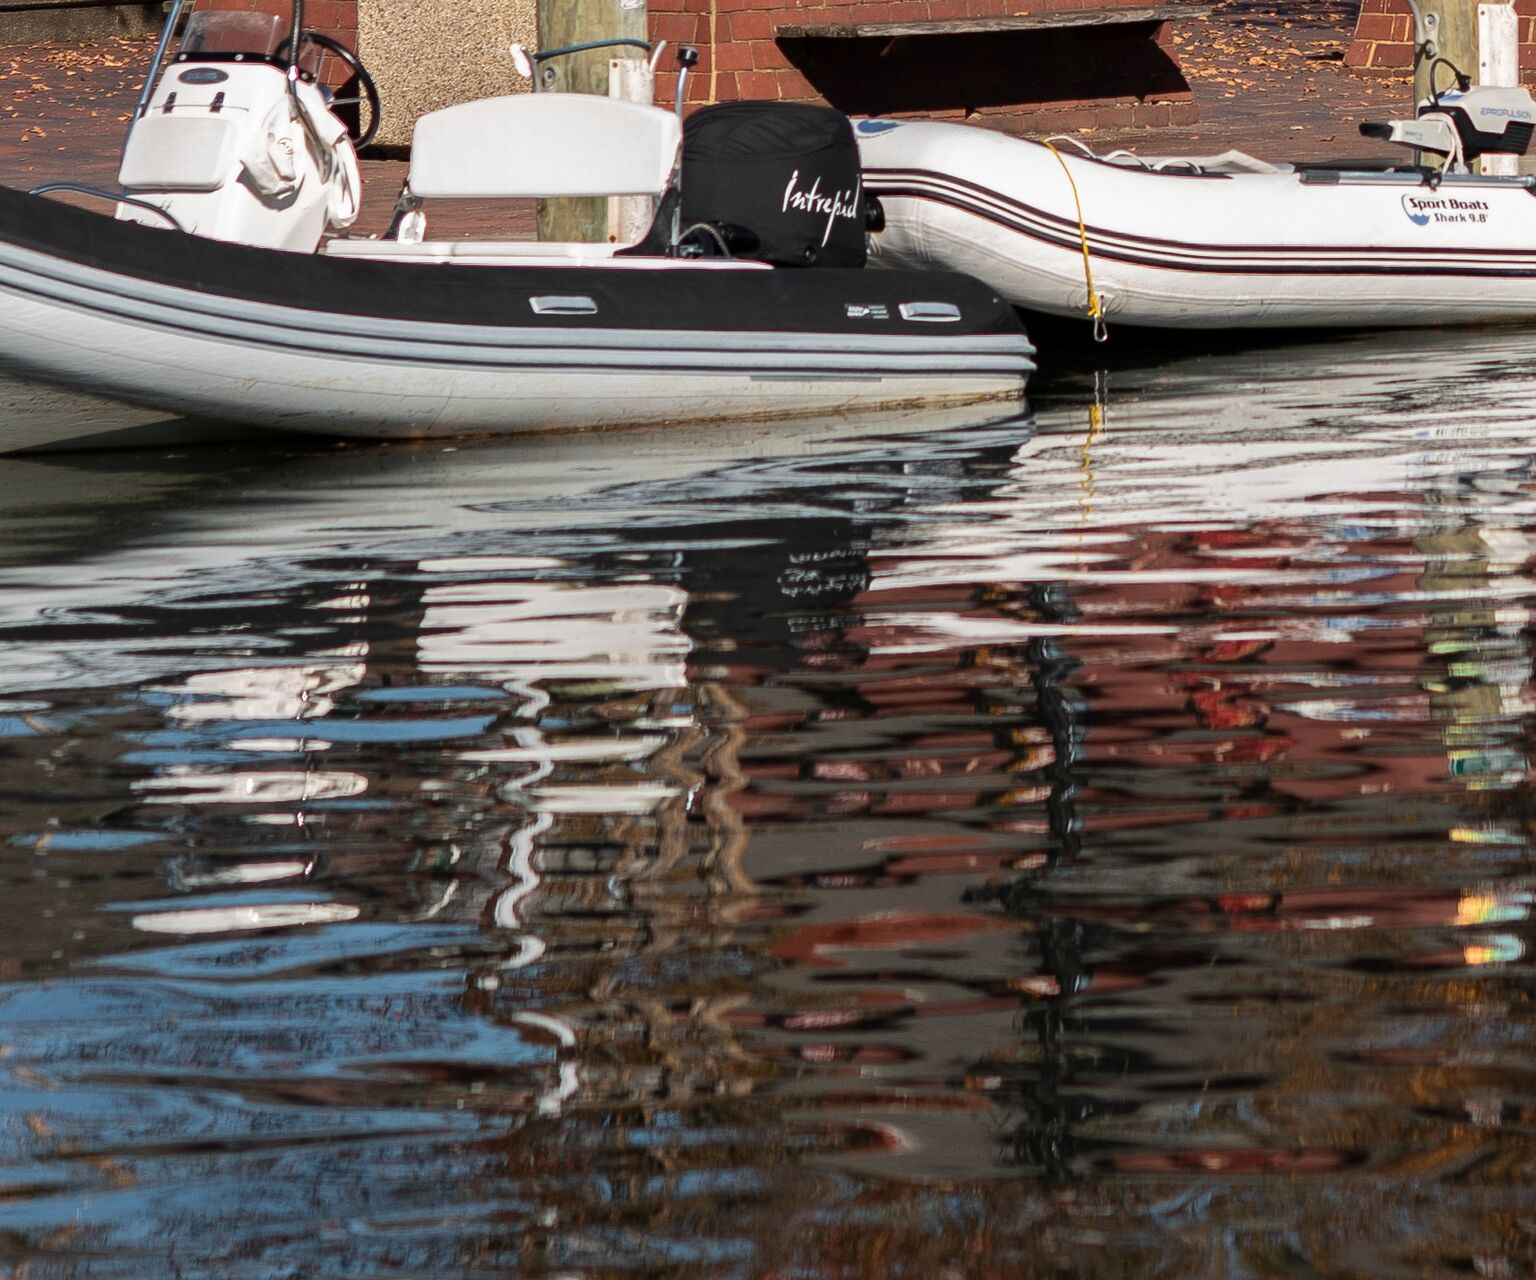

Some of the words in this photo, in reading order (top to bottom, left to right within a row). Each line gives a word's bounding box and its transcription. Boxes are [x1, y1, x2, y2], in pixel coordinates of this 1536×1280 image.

[782, 170, 860, 248] Intrepid
[1409, 198, 1447, 211] Sport
[1449, 198, 1489, 210] Boats
[1434, 213, 1467, 223] Shark
